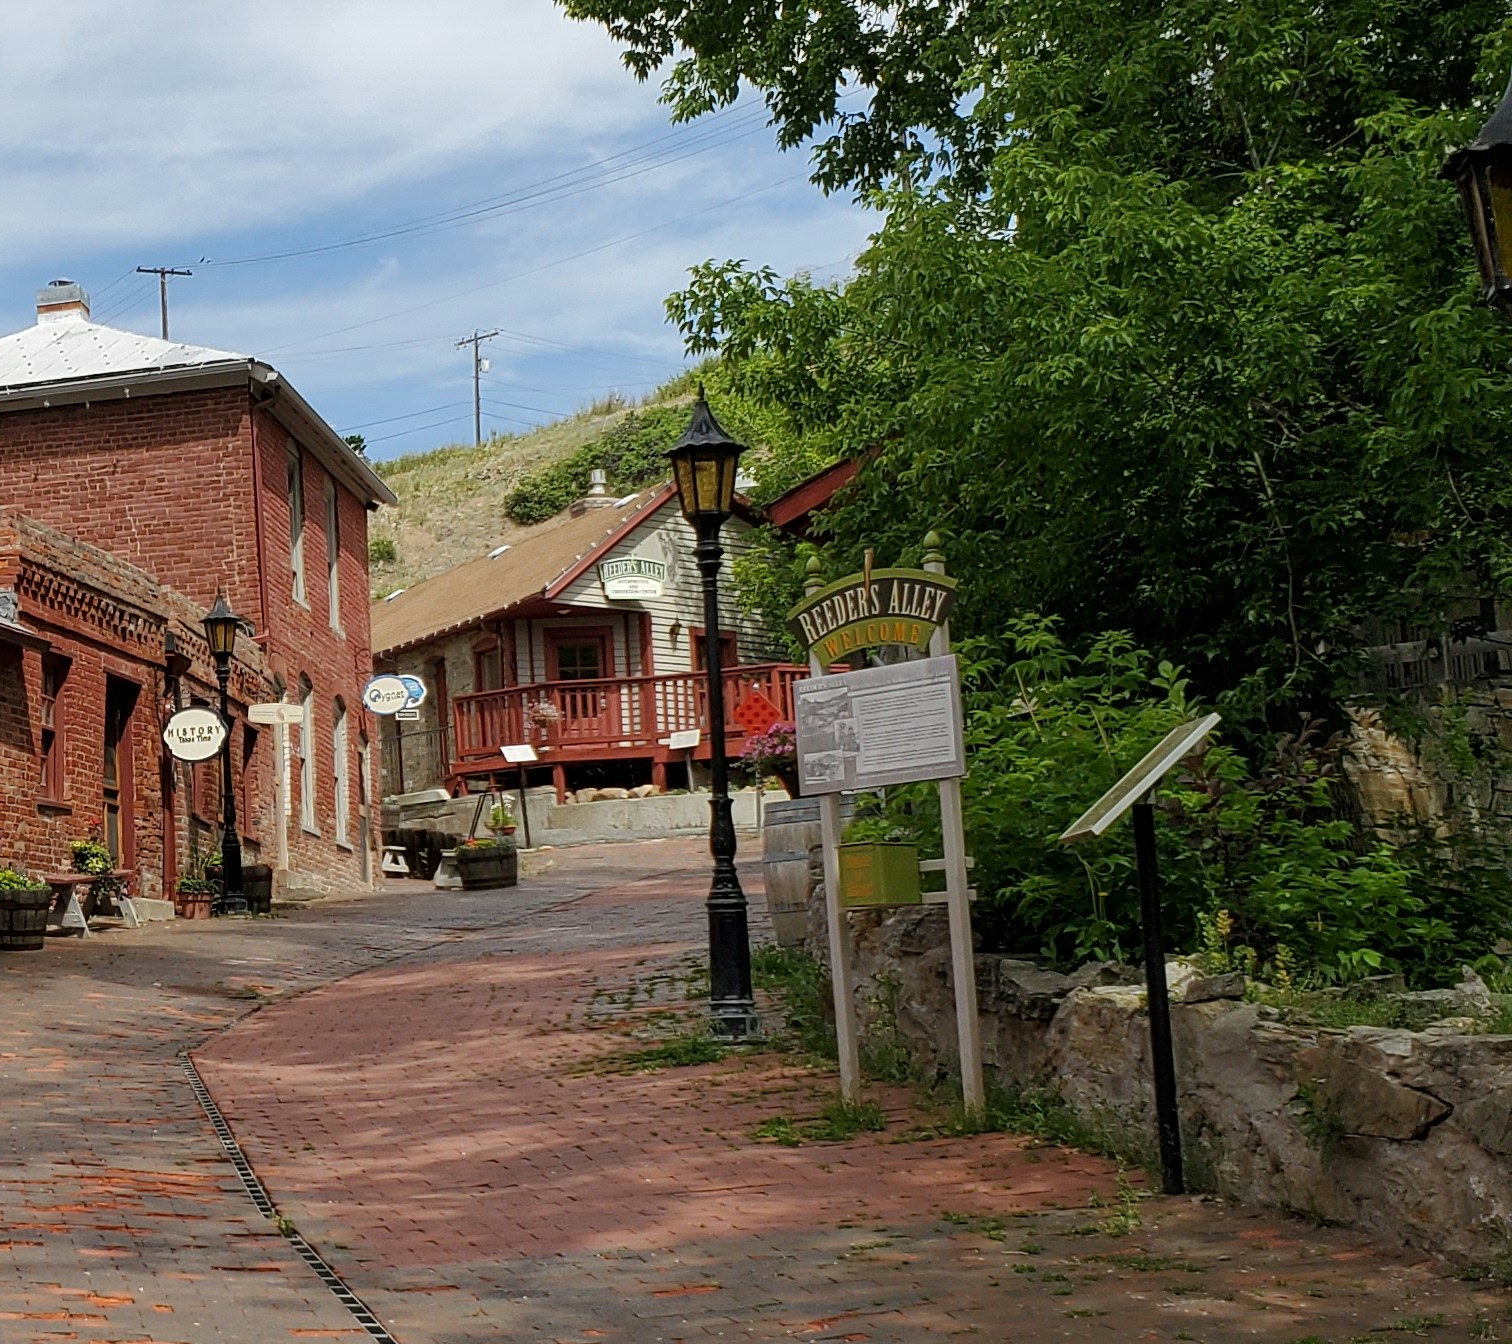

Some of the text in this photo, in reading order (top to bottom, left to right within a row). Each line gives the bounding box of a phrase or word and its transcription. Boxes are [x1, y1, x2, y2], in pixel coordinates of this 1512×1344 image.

[640, 560, 664, 580] ALLEY
[798, 579, 948, 645] REEDERS ALLEY
[823, 622, 921, 658] WELCOME
[167, 725, 221, 738] HISTORY
